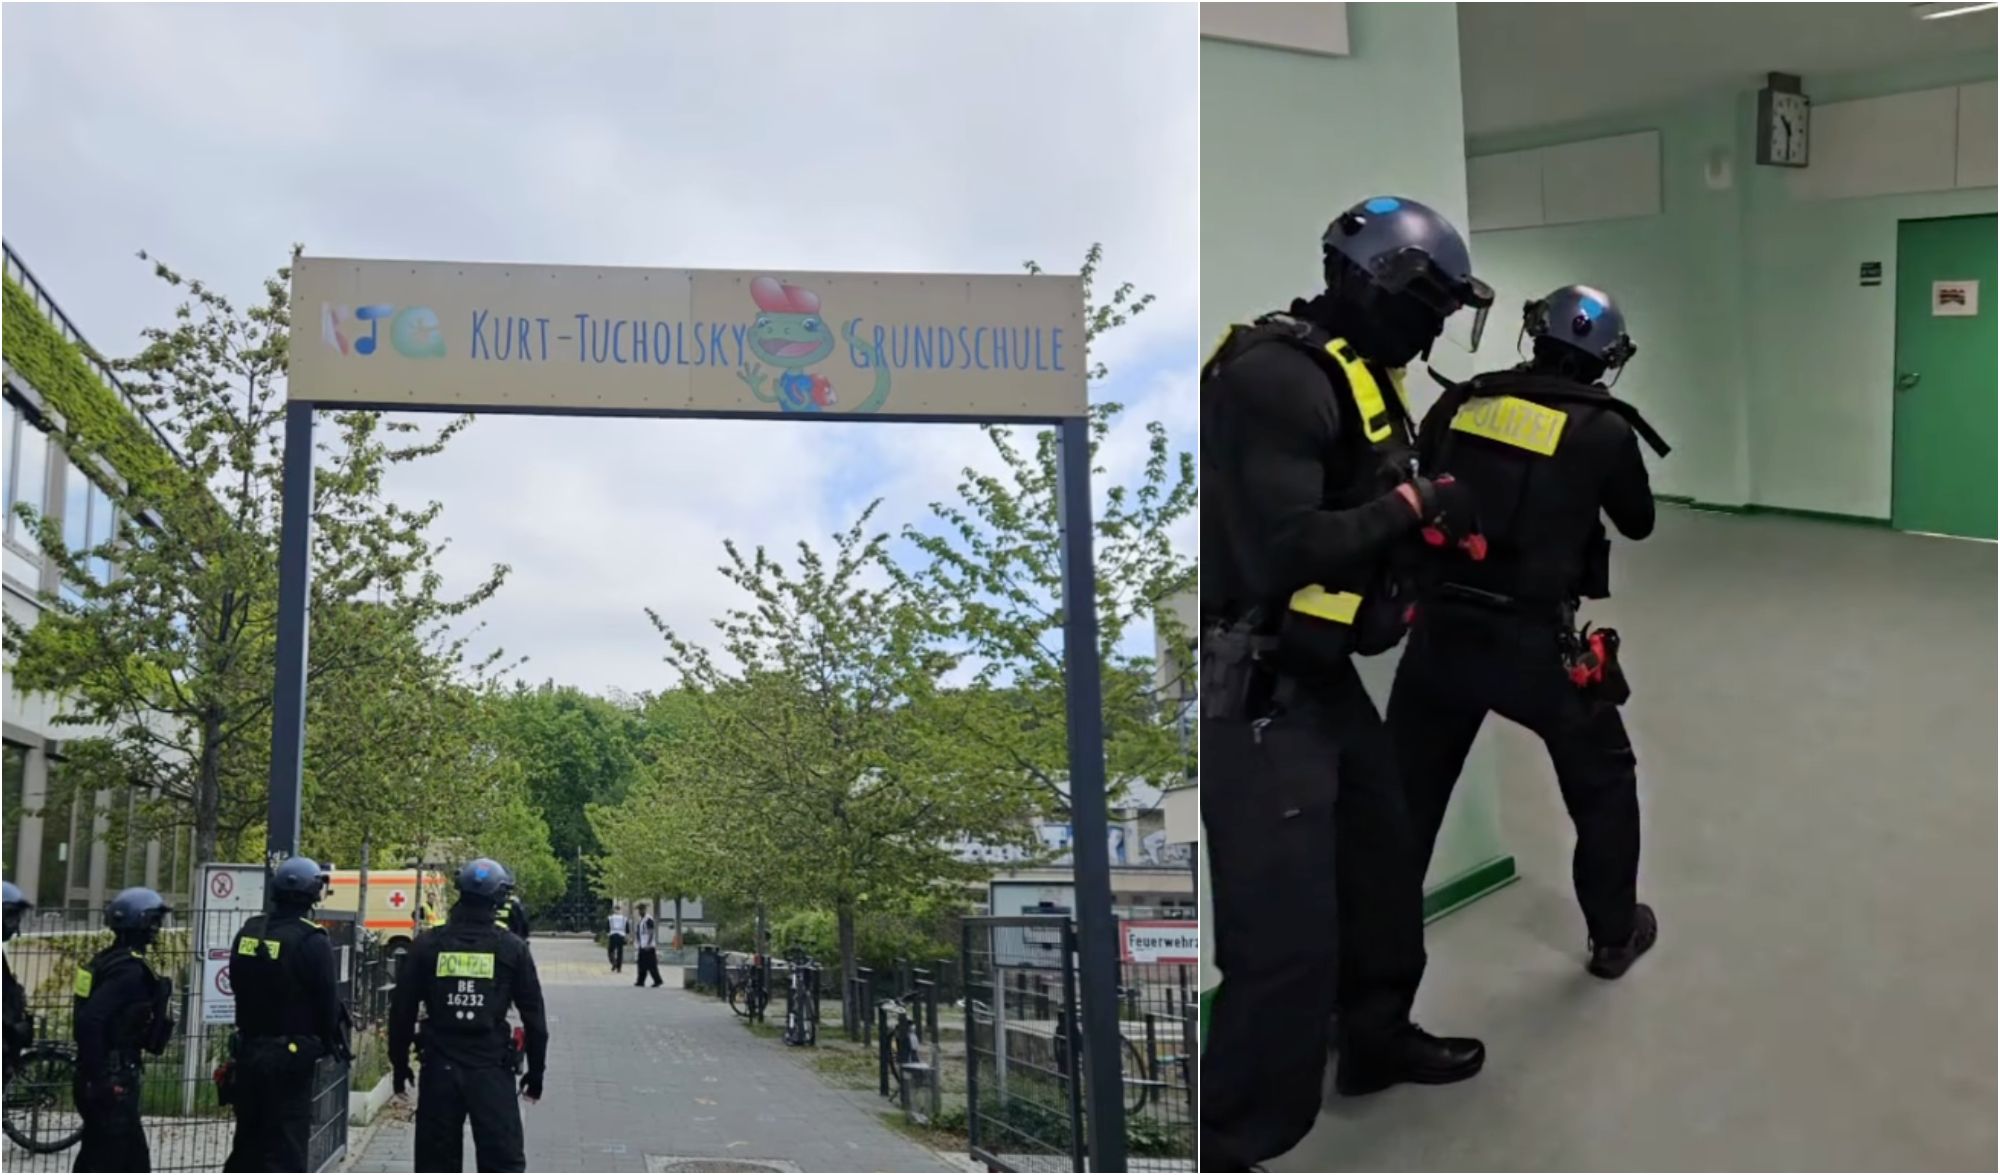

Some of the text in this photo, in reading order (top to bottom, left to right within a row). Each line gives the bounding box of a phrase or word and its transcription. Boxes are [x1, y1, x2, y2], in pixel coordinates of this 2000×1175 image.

[470, 309, 748, 367] KURT-TUCHOLSKY
[848, 316, 1065, 371] GRUNDSCHULE
[457, 980, 475, 993] BE
[447, 993, 484, 1006] 16232
